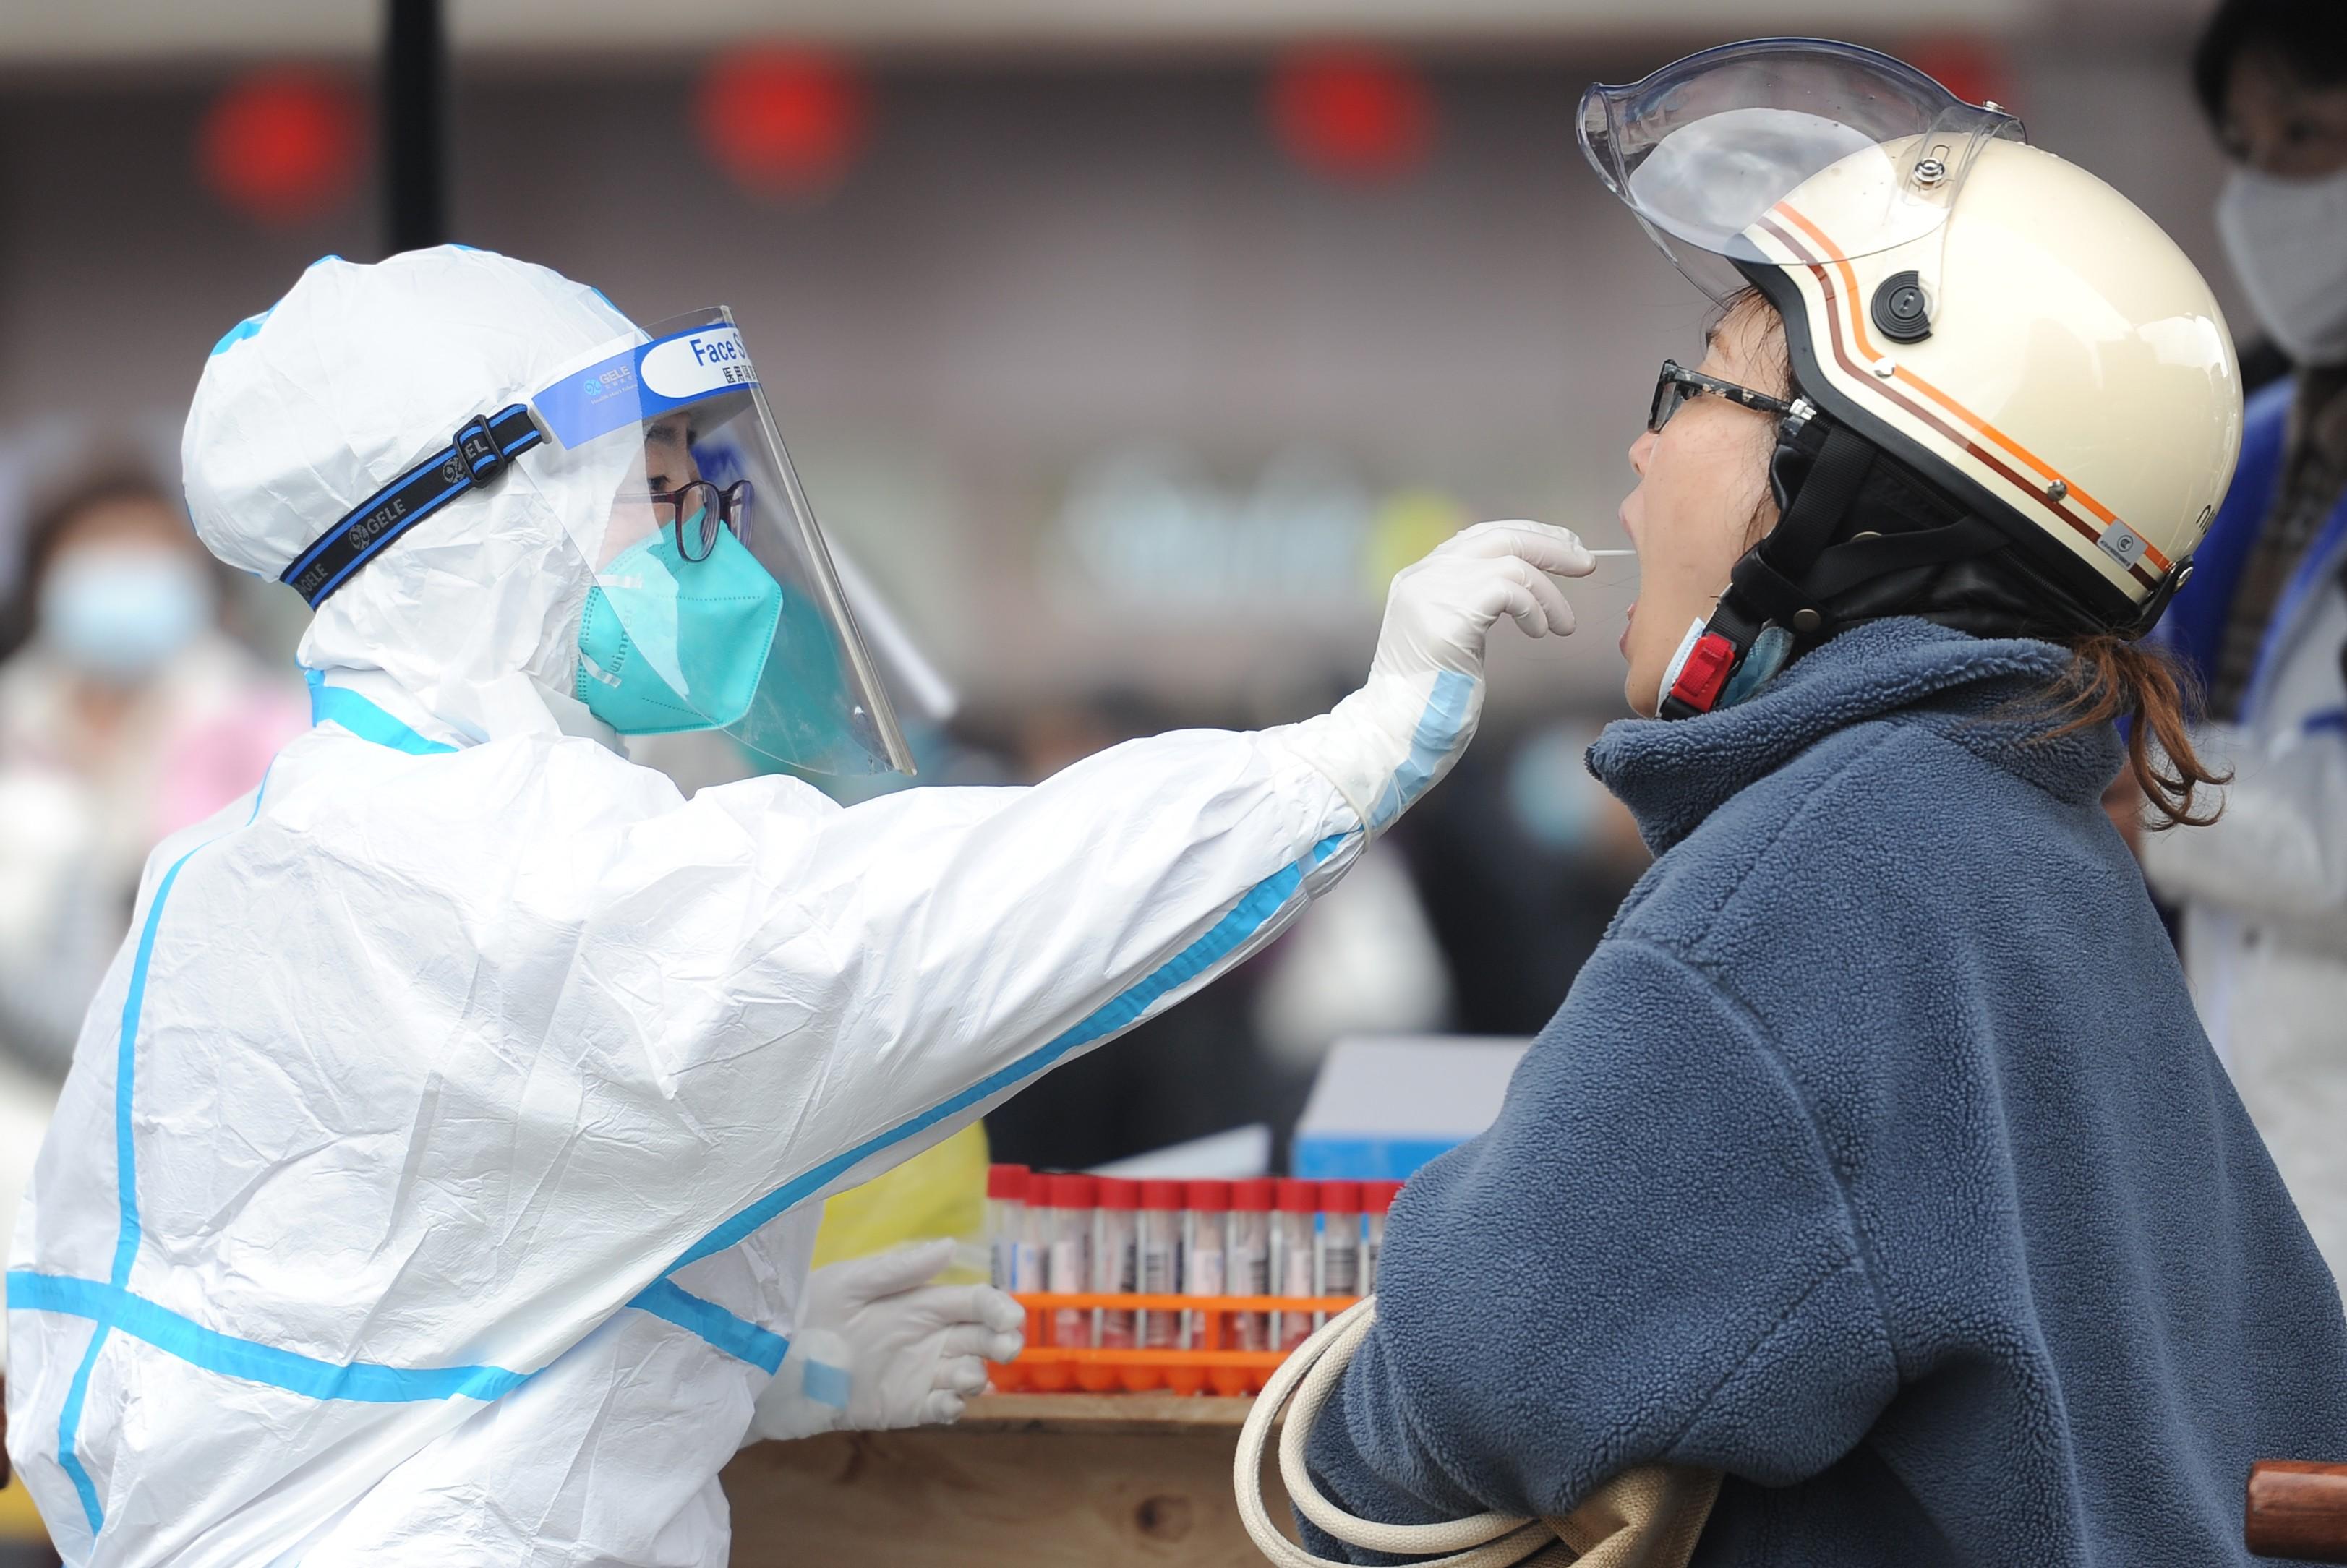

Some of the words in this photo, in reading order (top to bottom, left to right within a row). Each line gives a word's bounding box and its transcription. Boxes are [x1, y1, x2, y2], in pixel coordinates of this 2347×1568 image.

[689, 338, 737, 367] Face
[732, 332, 745, 359] S
[599, 364, 631, 385] GELE
[367, 498, 406, 534] GELE
[300, 563, 329, 591] GELE
[609, 604, 634, 673] winner
